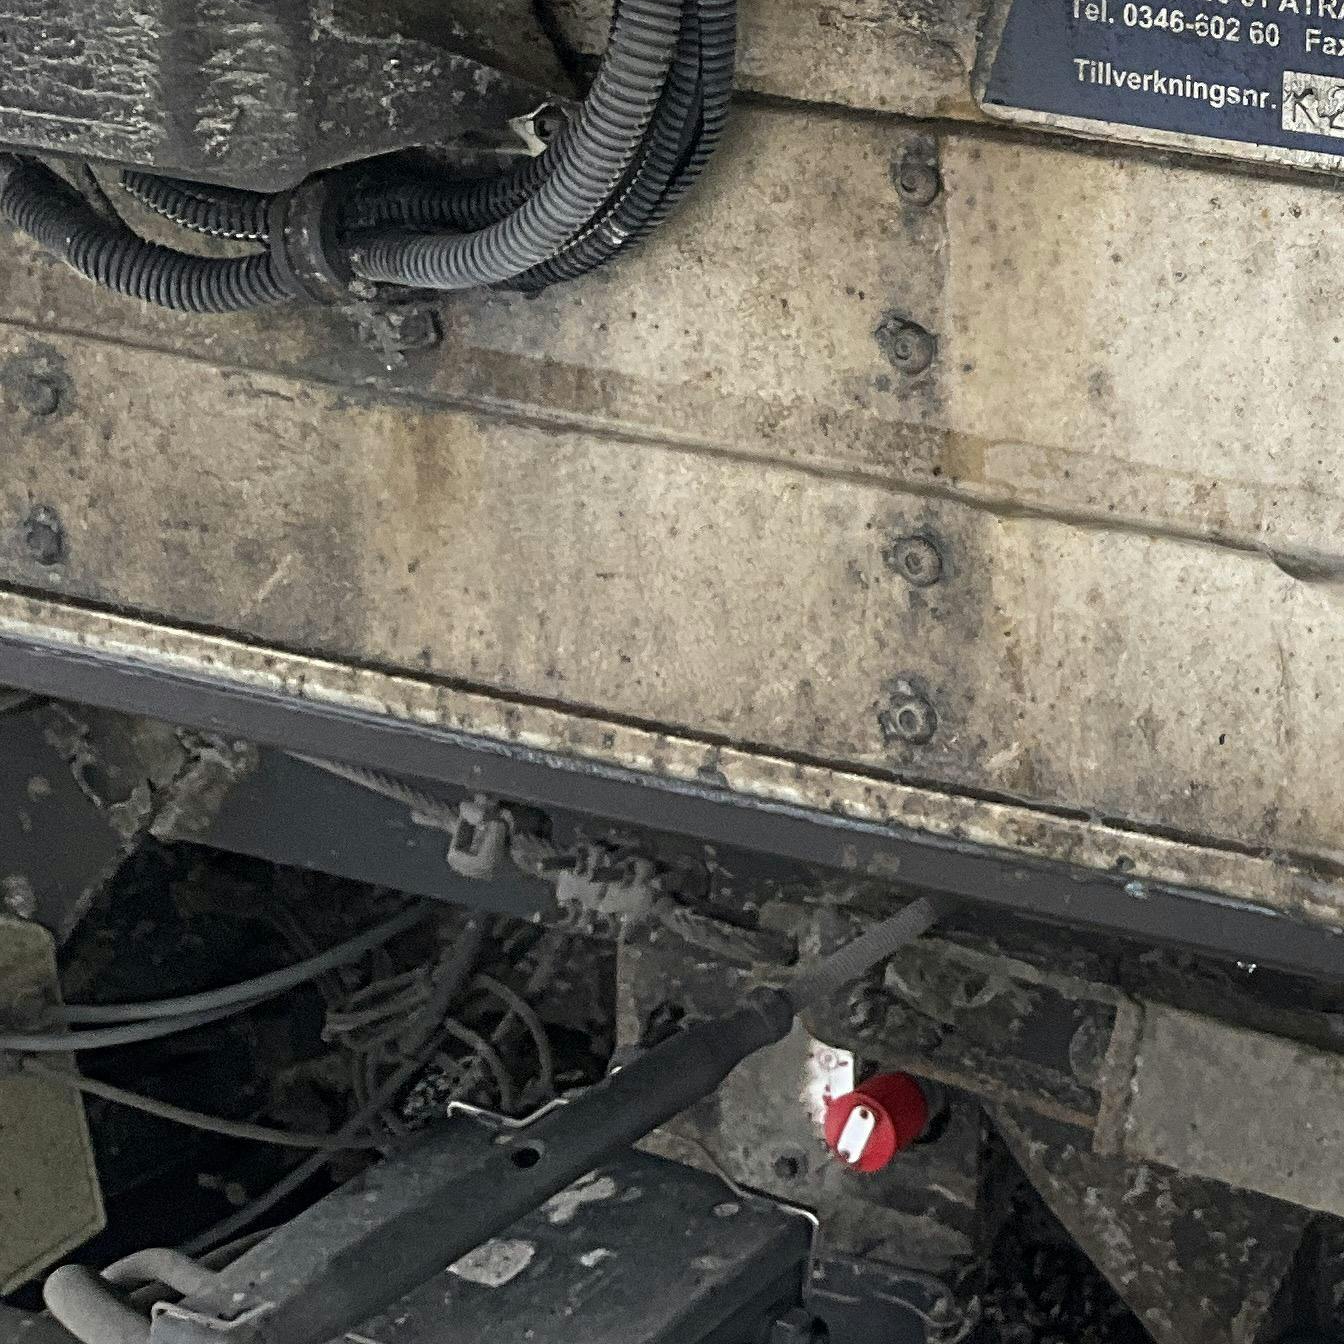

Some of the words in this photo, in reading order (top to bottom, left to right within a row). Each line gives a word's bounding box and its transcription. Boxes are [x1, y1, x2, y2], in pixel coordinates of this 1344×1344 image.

[1122, 2, 1241, 42] 0346-602
[1249, 20, 1281, 47] 60
[1073, 58, 1278, 110] Tillverkningsnr.
